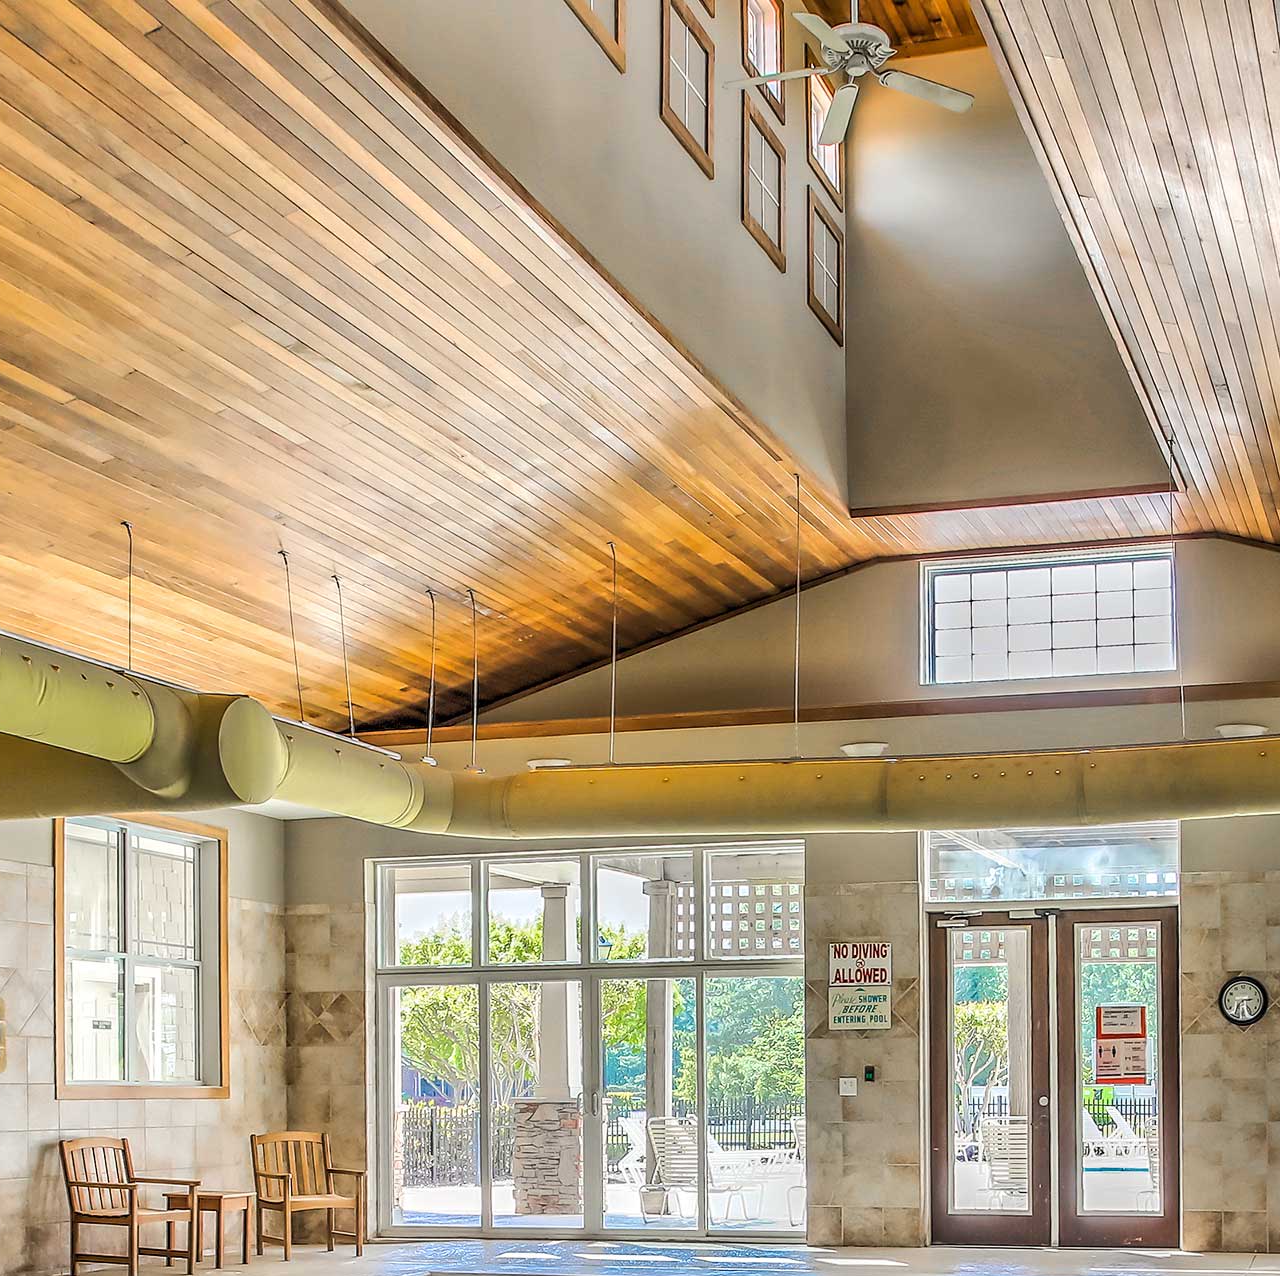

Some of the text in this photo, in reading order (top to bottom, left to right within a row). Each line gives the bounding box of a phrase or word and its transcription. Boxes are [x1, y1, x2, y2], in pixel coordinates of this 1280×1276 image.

[833, 943, 888, 959] NO DIVING
[834, 967, 888, 984] ALLOWED
[858, 994, 888, 1004] SHOWER
[842, 1004, 879, 1014] BEFORE
[833, 1014, 889, 1024] ENTERING POOL
